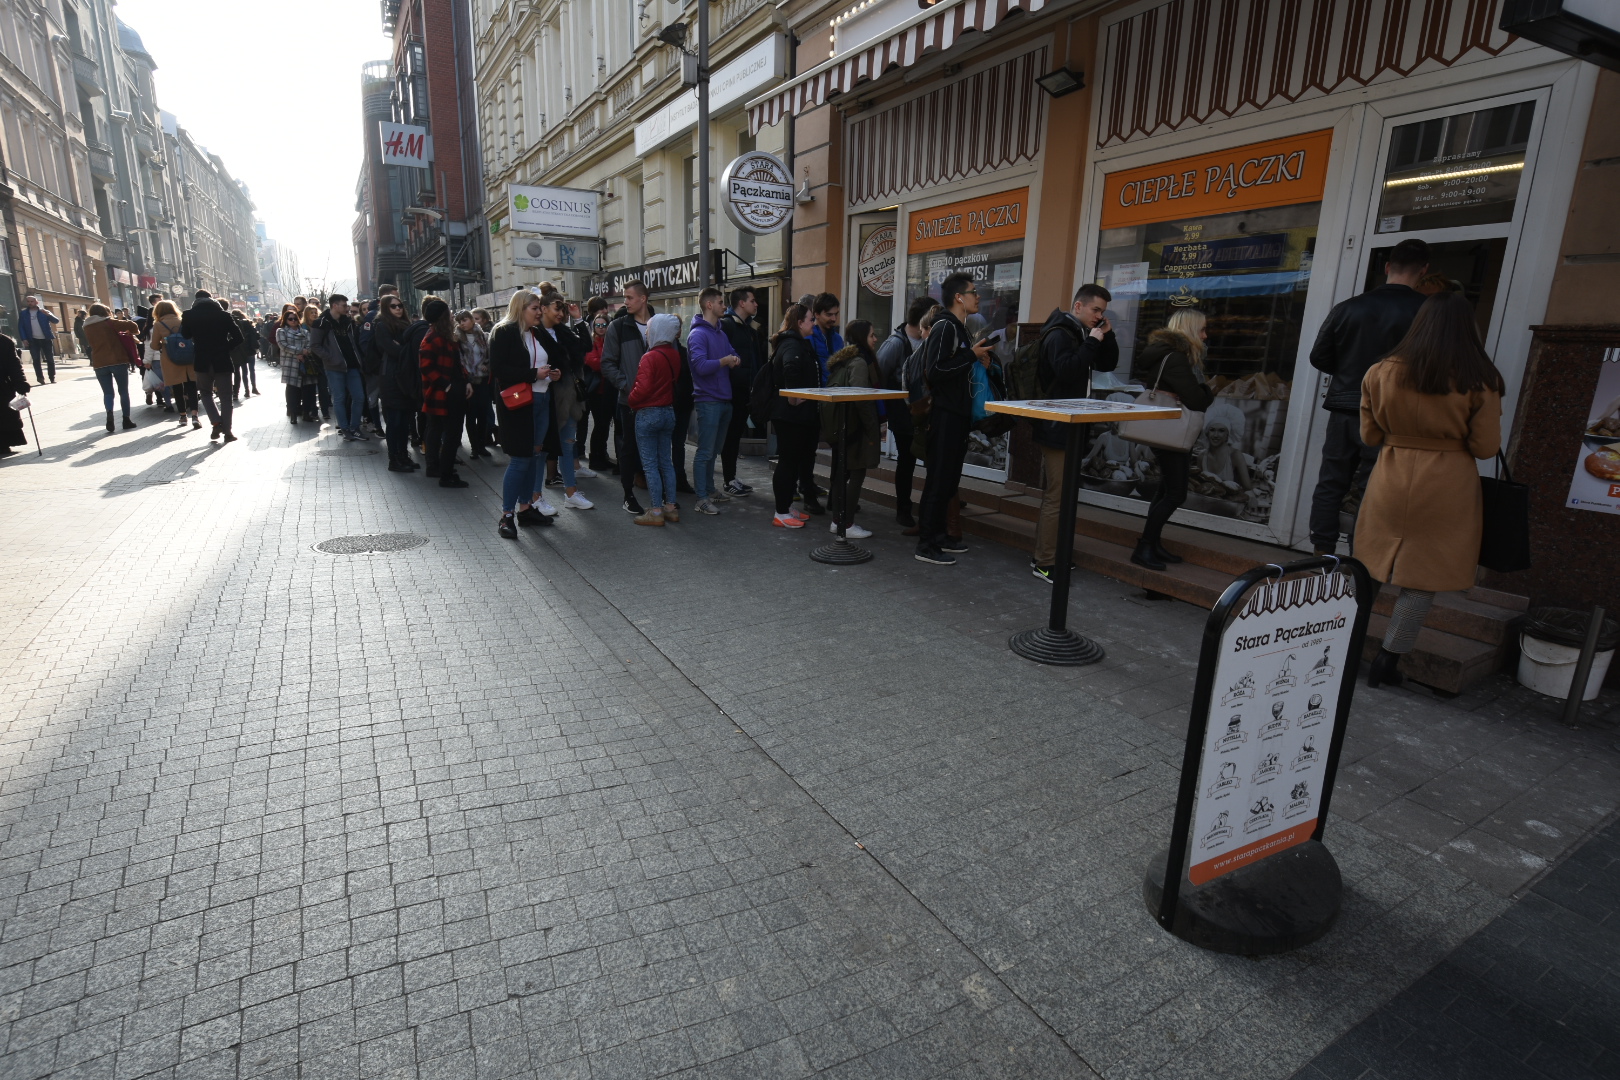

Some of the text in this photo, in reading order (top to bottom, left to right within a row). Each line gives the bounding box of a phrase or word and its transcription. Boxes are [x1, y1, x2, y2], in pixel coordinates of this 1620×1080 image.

[385, 131, 424, 160] H&M
[751, 160, 774, 173] STARA
[1119, 150, 1306, 208] CIEPŁE PĄCZKI
[732, 183, 792, 202] Pączkarnia
[915, 202, 1021, 241] ŚWIEŻE PĄCZKI
[1183, 224, 1203, 232] Kawa
[1184, 231, 1200, 241] 2,99
[1173, 244, 1208, 253] Herbata
[945, 256, 953, 266] 10
[954, 252, 990, 267] pączków
[1181, 252, 1198, 261] 2,99
[862, 256, 896, 278] Pączka
[1163, 262, 1214, 273] Cappuccino
[590, 280, 594, 294] 4
[595, 281, 610, 297] eyes
[643, 260, 699, 289] OPTYCZNY
[1178, 271, 1195, 280] 2,99
[1234, 616, 1347, 653] Stara Pączkarnia
[1301, 641, 1310, 649] od
[1213, 832, 1296, 870] www.starapaczkarnia.pl
